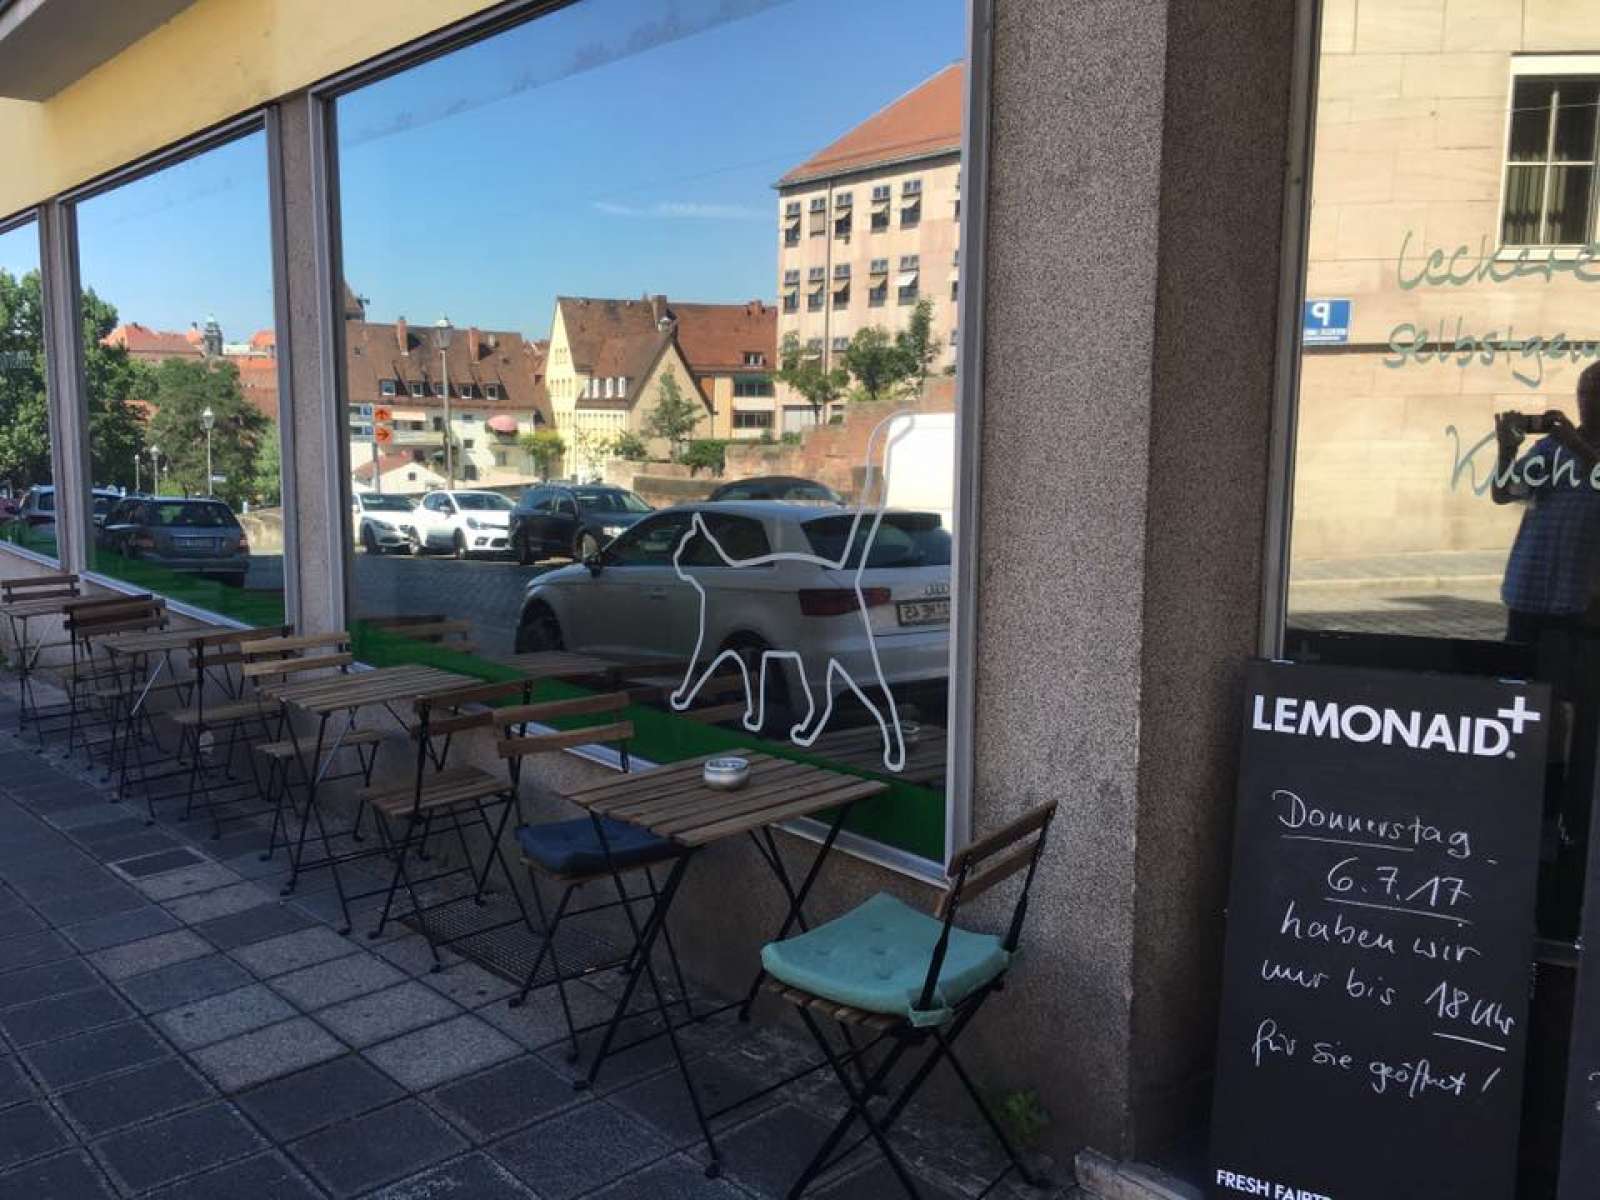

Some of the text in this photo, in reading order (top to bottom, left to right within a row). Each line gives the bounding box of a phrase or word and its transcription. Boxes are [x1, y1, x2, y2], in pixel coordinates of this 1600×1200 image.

[1398, 230, 1600, 290] Leckere
[1272, 789, 1471, 858] Donnerstag
[1327, 856, 1473, 906] 6.7.17
[1280, 900, 1481, 962] haben wir
[1345, 966, 1396, 1006] bis
[1216, 1168, 1270, 1198] FRESH
